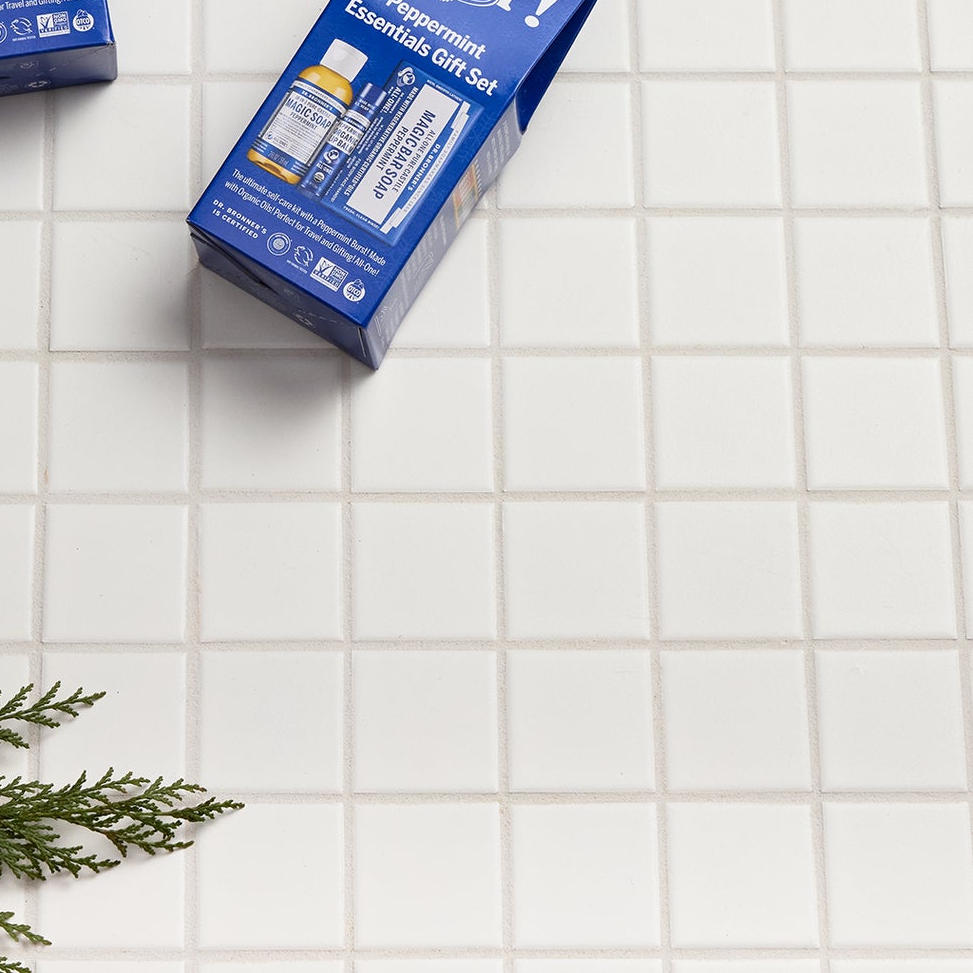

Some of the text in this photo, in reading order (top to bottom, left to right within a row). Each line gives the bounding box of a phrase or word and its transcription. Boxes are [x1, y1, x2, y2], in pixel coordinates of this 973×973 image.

[285, 97, 331, 131] MAGIC SOAP
[431, 48, 466, 77] Gift
[464, 67, 497, 96] Set
[372, 109, 435, 199] MAGIC BAR SOAP
[224, 180, 379, 275] with Organic Oils! Perfect for Travel and Gifting! All-One!
[232, 168, 243, 180] The
[242, 176, 267, 194] ultimate
[266, 190, 292, 209] self-care
[291, 204, 301, 214] kit
[299, 210, 313, 222] with
[316, 219, 352, 245] Peppermint
[350, 239, 370, 255] Burst!
[367, 250, 385, 265] Made
